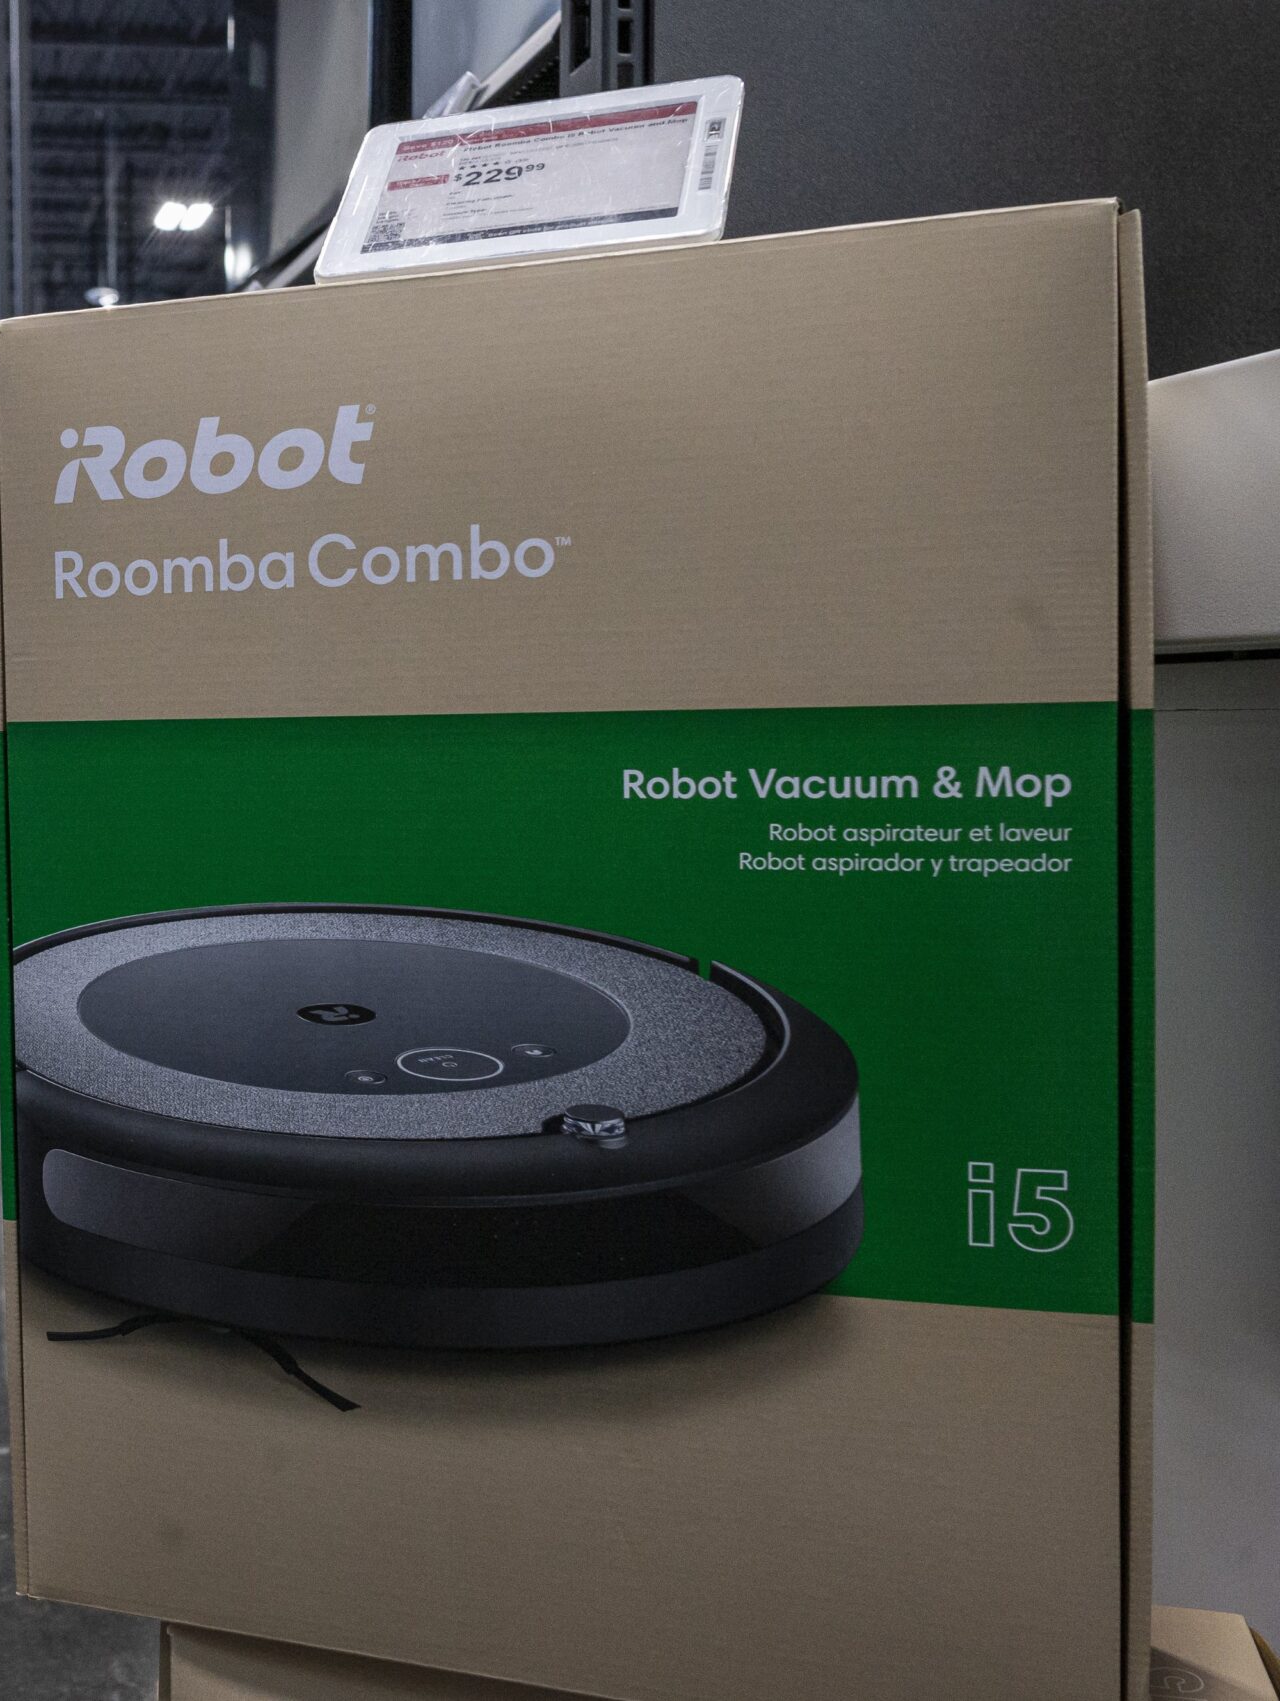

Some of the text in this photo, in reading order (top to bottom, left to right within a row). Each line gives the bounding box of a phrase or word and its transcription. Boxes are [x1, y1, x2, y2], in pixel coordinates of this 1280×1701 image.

[54, 538, 295, 599] Roomba
[622, 766, 1073, 807] Robot Vacuum & Mop
[768, 823, 1073, 847] Robot aspirateur et laveur
[739, 852, 1073, 877] Robot aspirador y trapeador
[968, 1161, 1074, 1253] i5
